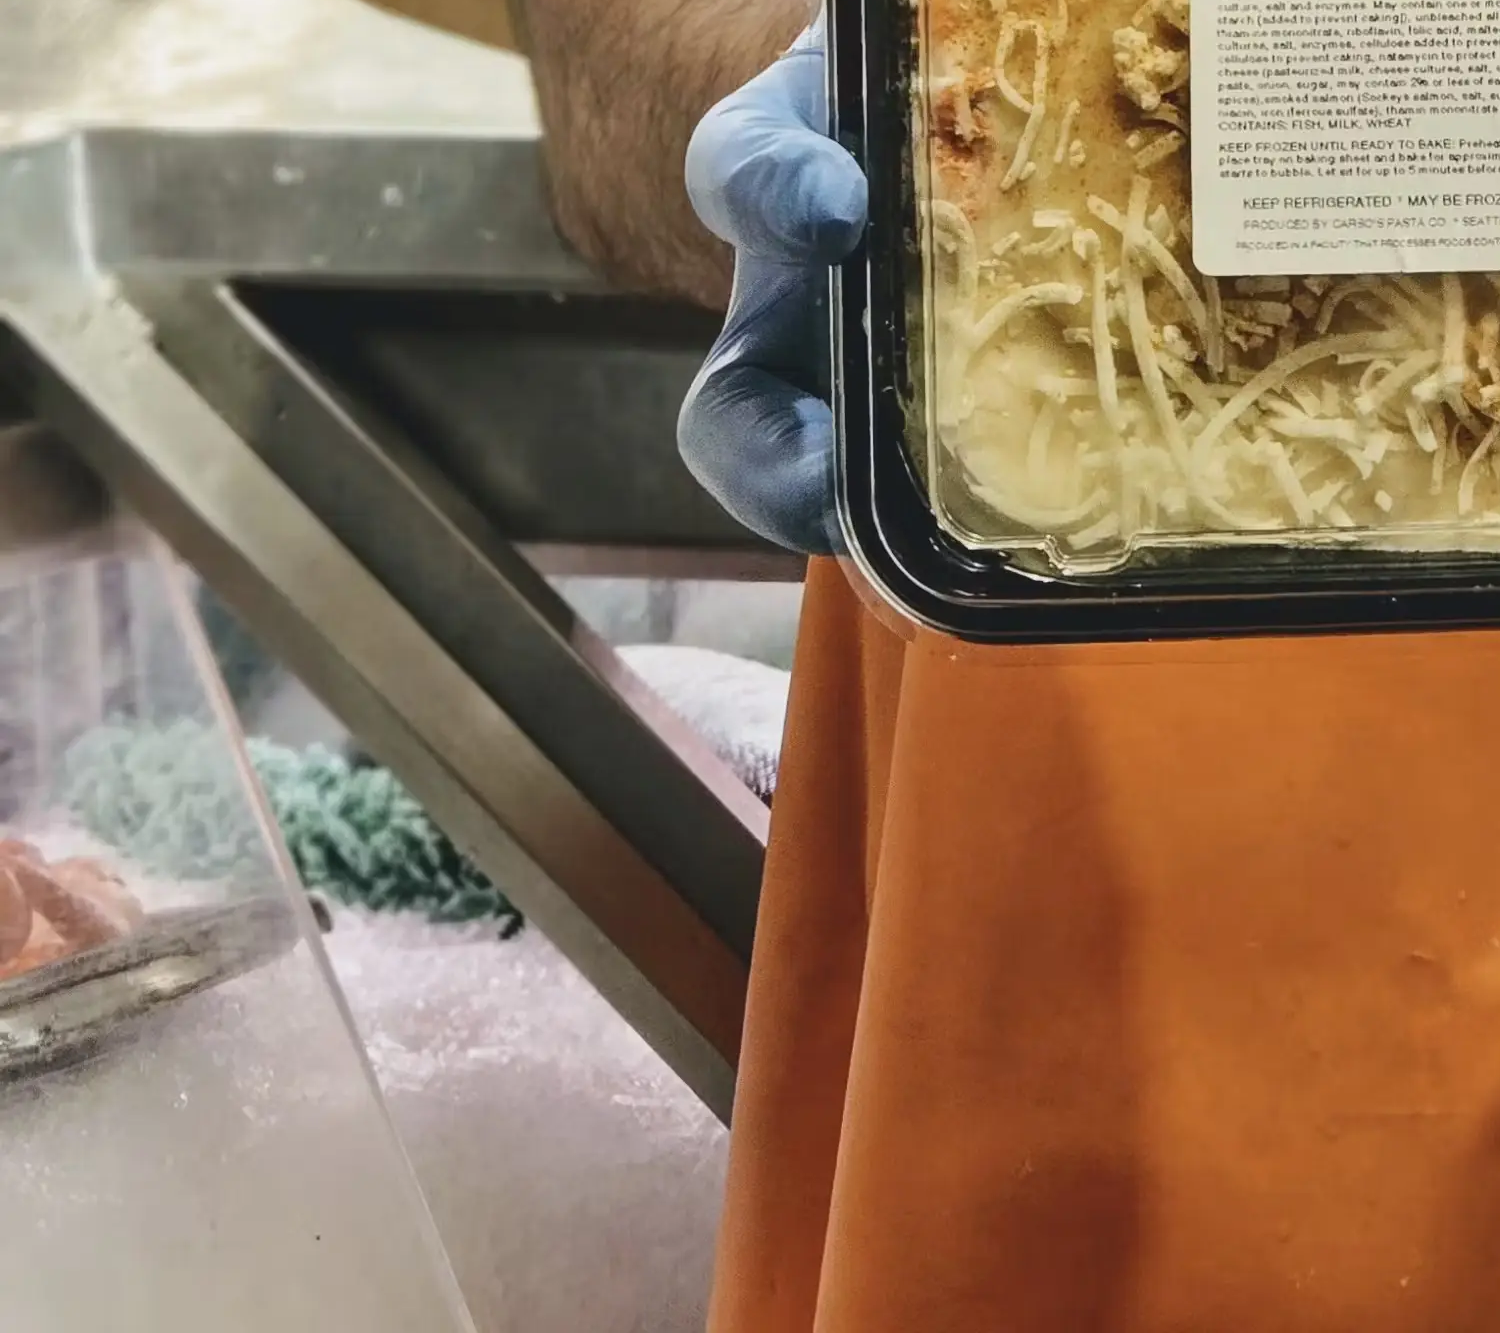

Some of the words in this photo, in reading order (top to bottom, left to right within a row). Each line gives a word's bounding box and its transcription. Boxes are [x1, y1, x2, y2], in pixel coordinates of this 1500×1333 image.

[1290, 1, 1312, 11] and
[1372, 0, 1398, 12] May
[1414, 12, 1482, 22] unbleached
[1360, 39, 1410, 49] cellulose
[1414, 37, 1448, 48] added
[1452, 38, 1463, 46] to
[1272, 55, 1283, 63] to
[1286, 53, 1330, 65] prevent
[1442, 52, 1453, 60] to
[1456, 51, 1496, 62] protect
[1432, 79, 1444, 87] or
[1448, 77, 1470, 86] less
[1473, 77, 1484, 85] of
[1312, 93, 1354, 103] salmon
[1218, 120, 1288, 131] CONTAINS:
[1366, 116, 1412, 129] WHEAT
[1218, 142, 1252, 153] KEEP
[1255, 142, 1308, 152] FROZEN
[1310, 141, 1348, 152] UNTIL
[1350, 140, 1394, 151] READY
[1398, 140, 1415, 149] TO
[1418, 138, 1456, 150] BAKE:
[1218, 155, 1250, 166] place
[1253, 156, 1276, 166] tray
[1296, 154, 1336, 166] baking
[1340, 154, 1370, 163] sheet
[1374, 153, 1396, 162] and
[1398, 153, 1426, 161] bake
[1428, 151, 1444, 162] for
[1256, 168, 1268, 177] to
[1317, 167, 1336, 176] Let
[1340, 168, 1352, 176] sit
[1356, 166, 1372, 176] for
[1376, 168, 1390, 177] up
[1394, 166, 1405, 175] to
[1408, 165, 1416, 175] 5
[1418, 165, 1465, 175] minutes
[1243, 197, 1280, 210] KEEP
[1284, 195, 1394, 209] REFRIGERATED
[1408, 195, 1439, 206] MAY
[1442, 194, 1462, 206] BE
[1243, 219, 1310, 231] PRODUCED
